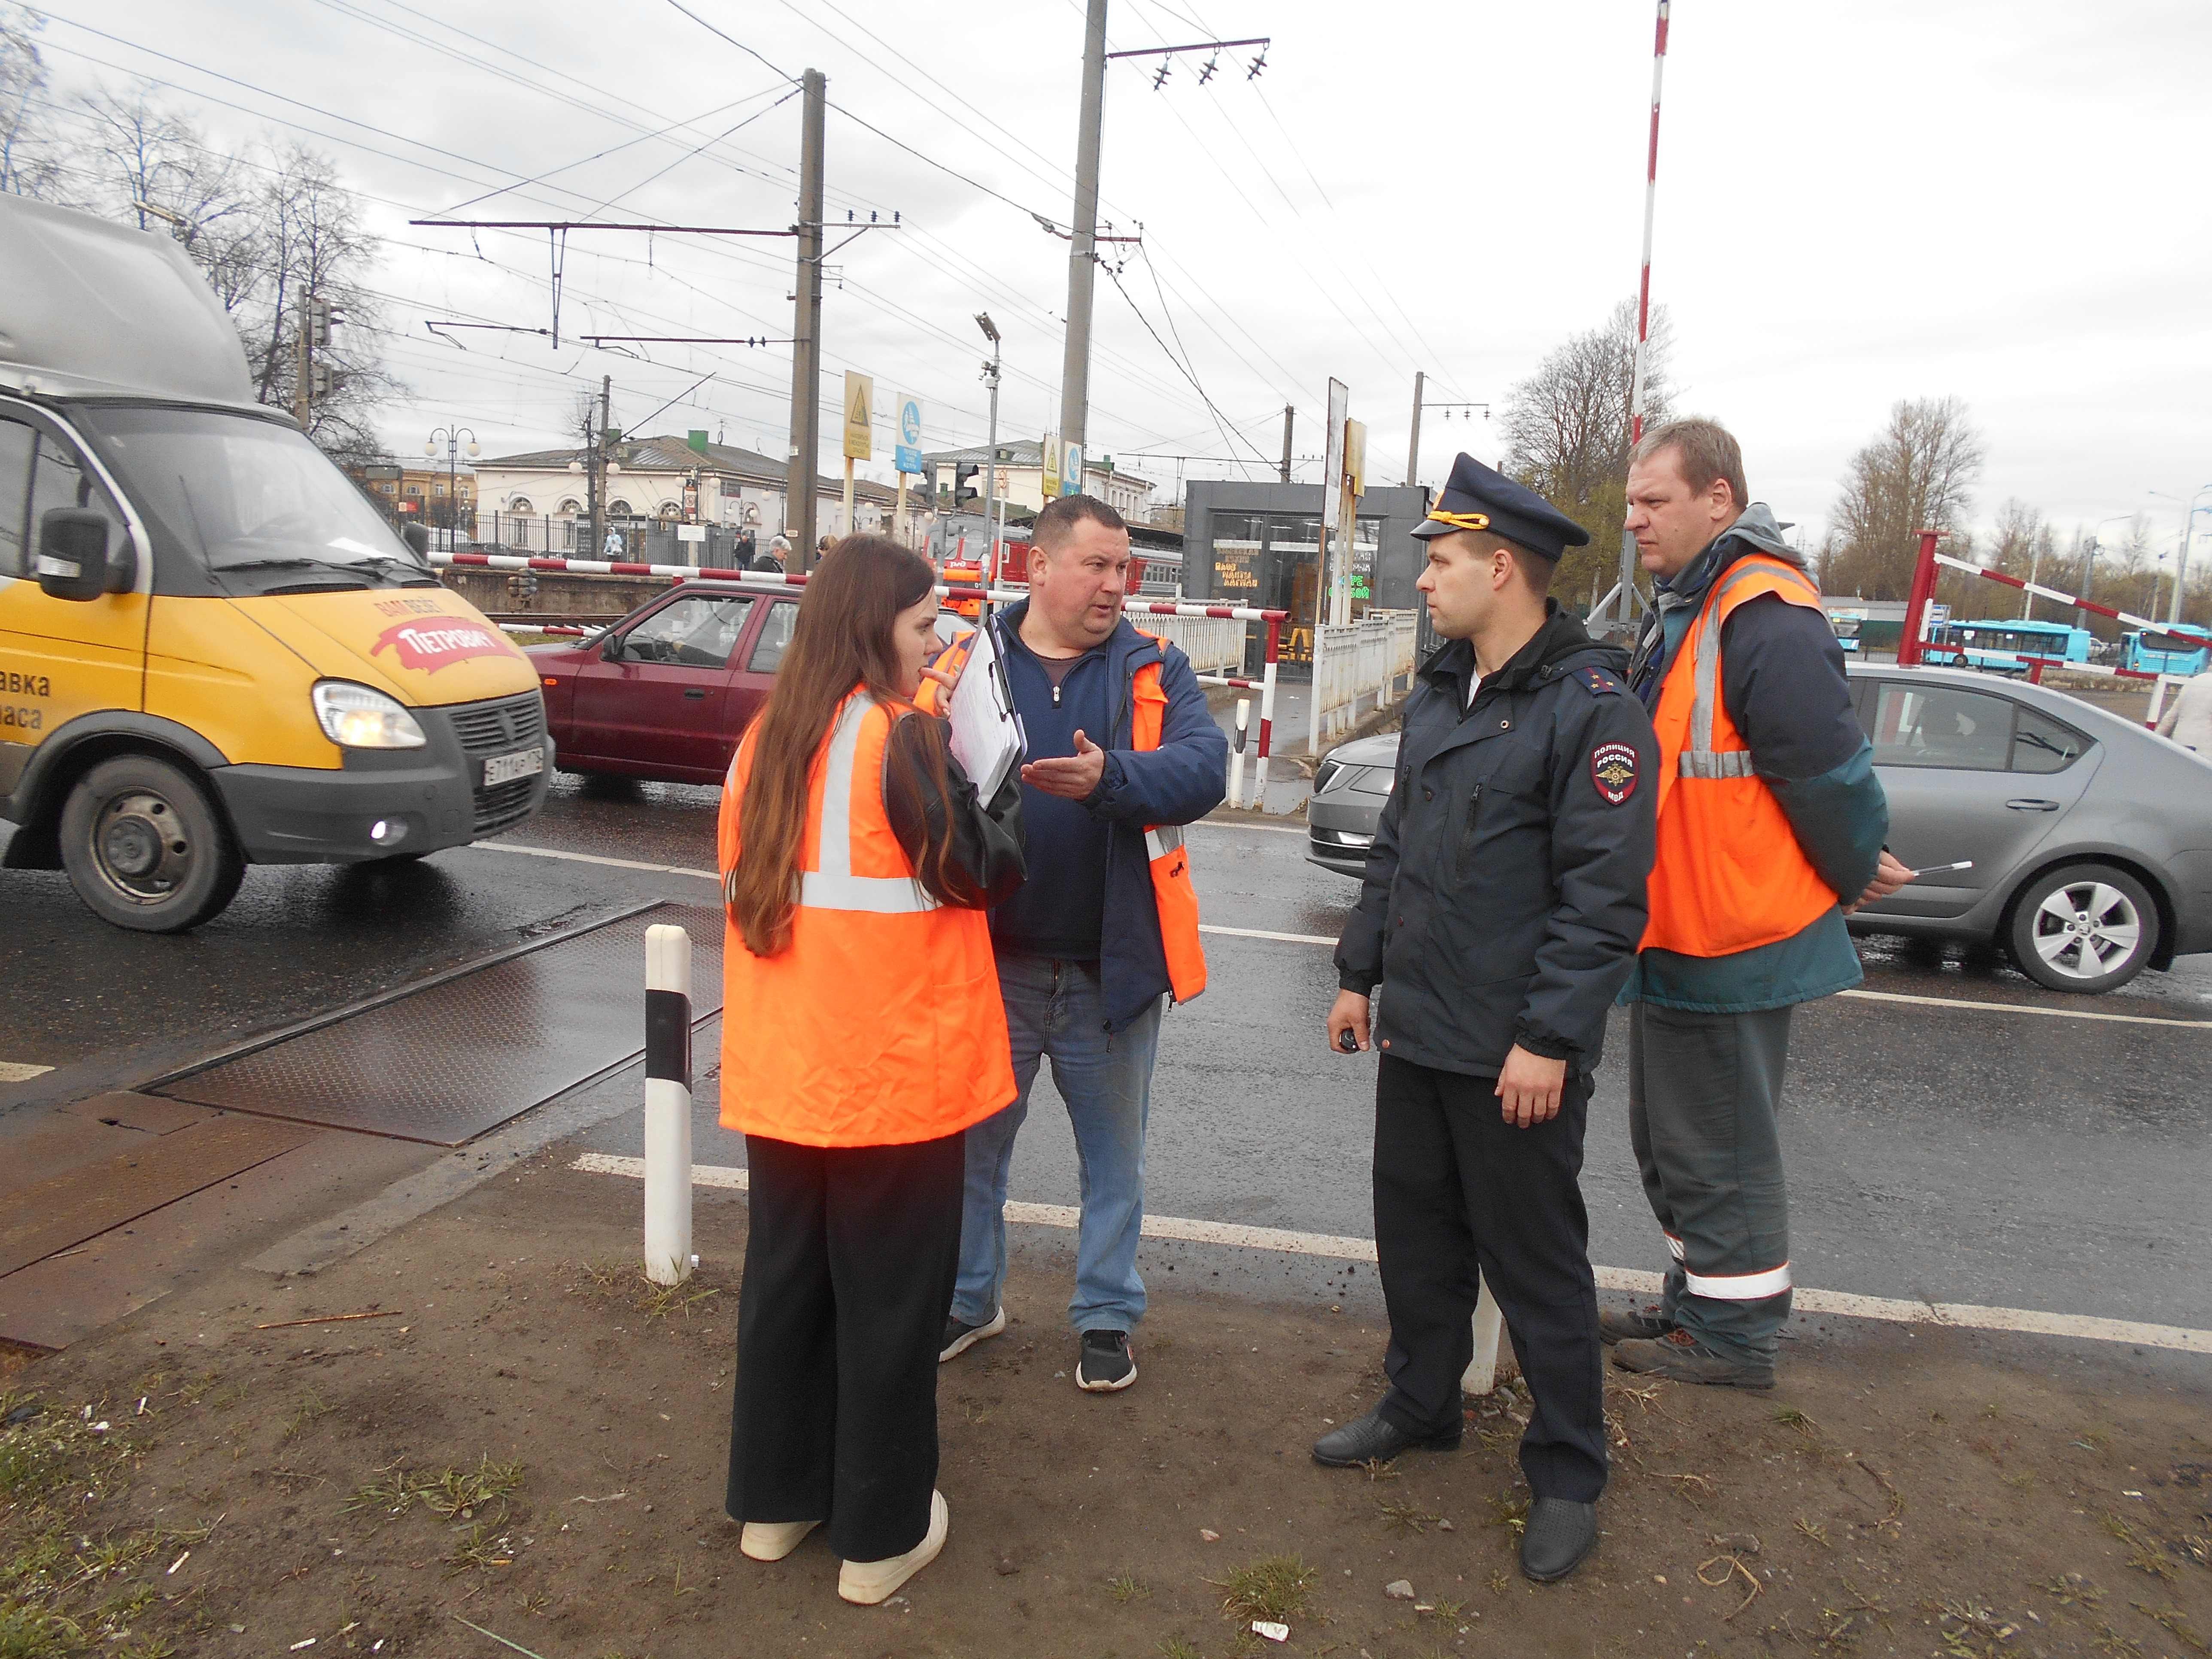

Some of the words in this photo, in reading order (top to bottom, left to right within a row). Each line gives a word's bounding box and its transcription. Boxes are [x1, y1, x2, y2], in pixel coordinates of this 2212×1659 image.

[397, 628, 496, 655] ПЕТРОВИЧ
[0, 705, 42, 729] аса
[1594, 744, 1635, 759] ПОЛИЦИЯ
[1597, 754, 1633, 768] РОССИЯ
[1607, 791, 1624, 802] МВД
